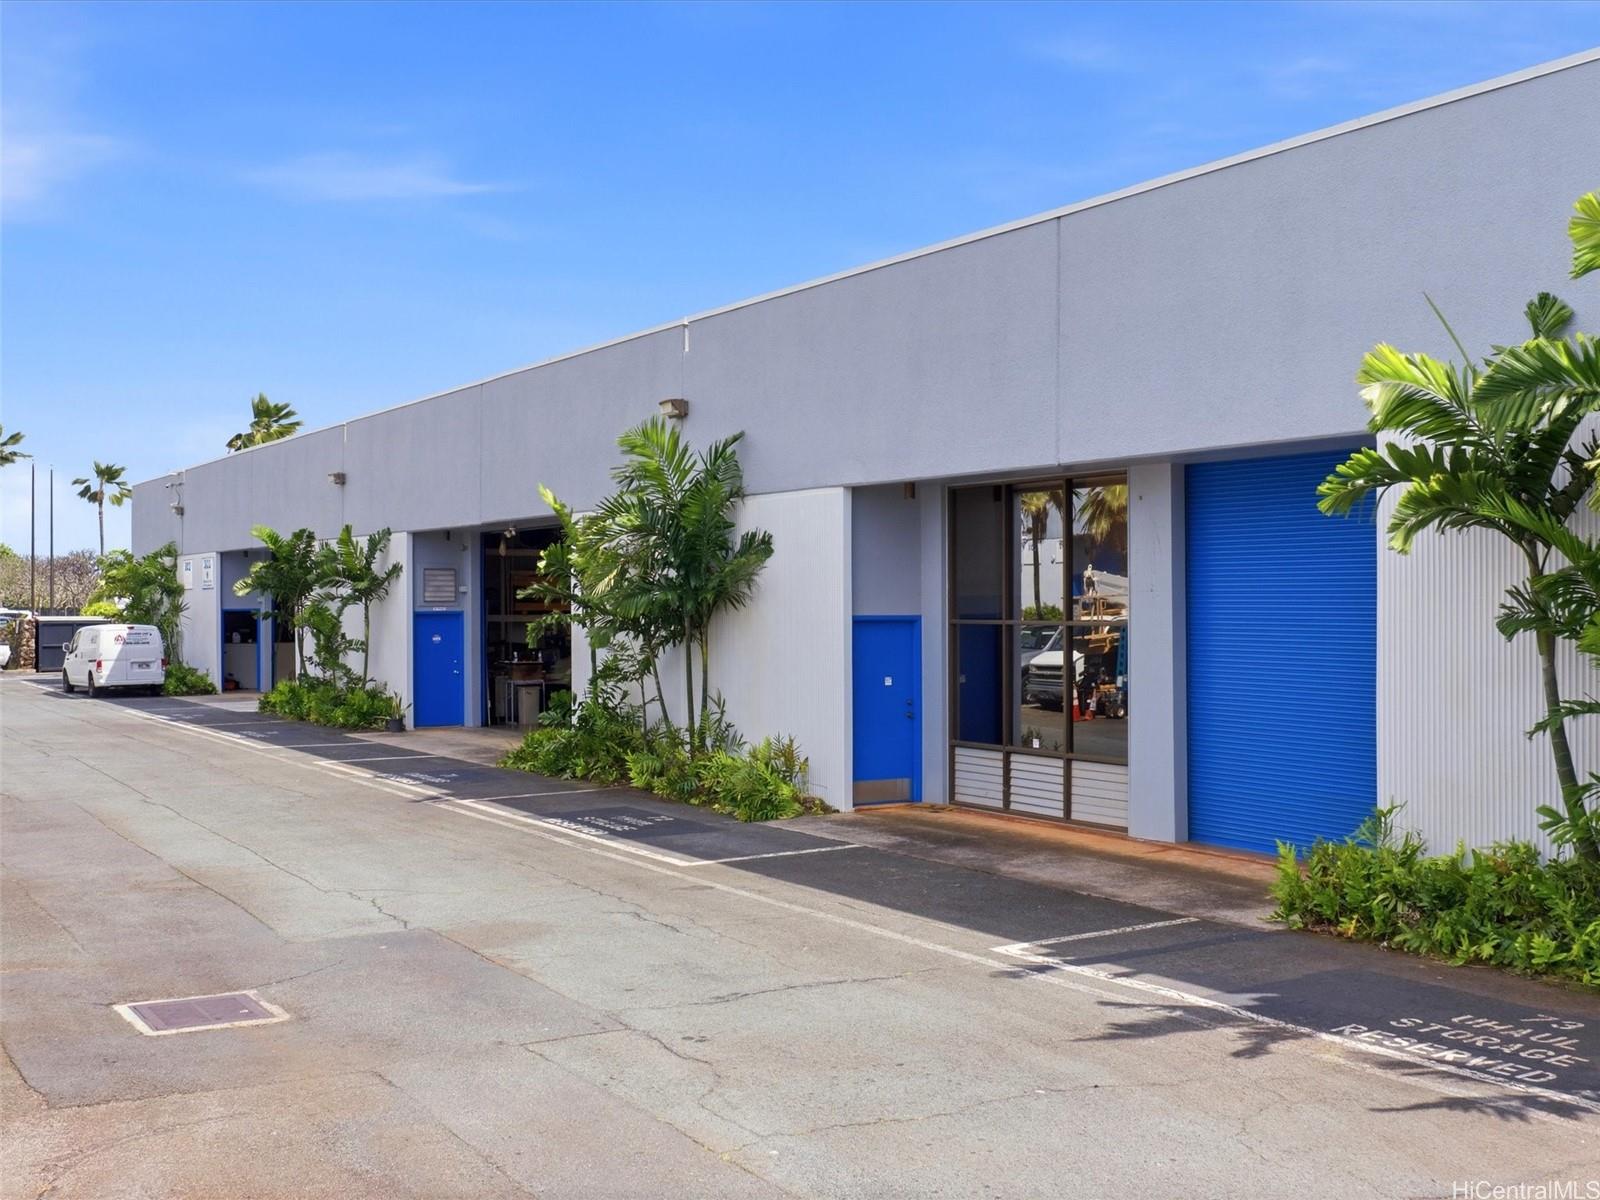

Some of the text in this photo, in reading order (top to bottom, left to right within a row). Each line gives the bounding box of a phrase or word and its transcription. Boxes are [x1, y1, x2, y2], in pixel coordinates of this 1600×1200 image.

[1389, 1017, 1590, 1067] STORAGE
[1451, 1014, 1580, 1051] UHAUL
[1520, 1013, 1585, 1030] 73
[1329, 1023, 1557, 1083] RESERVED
